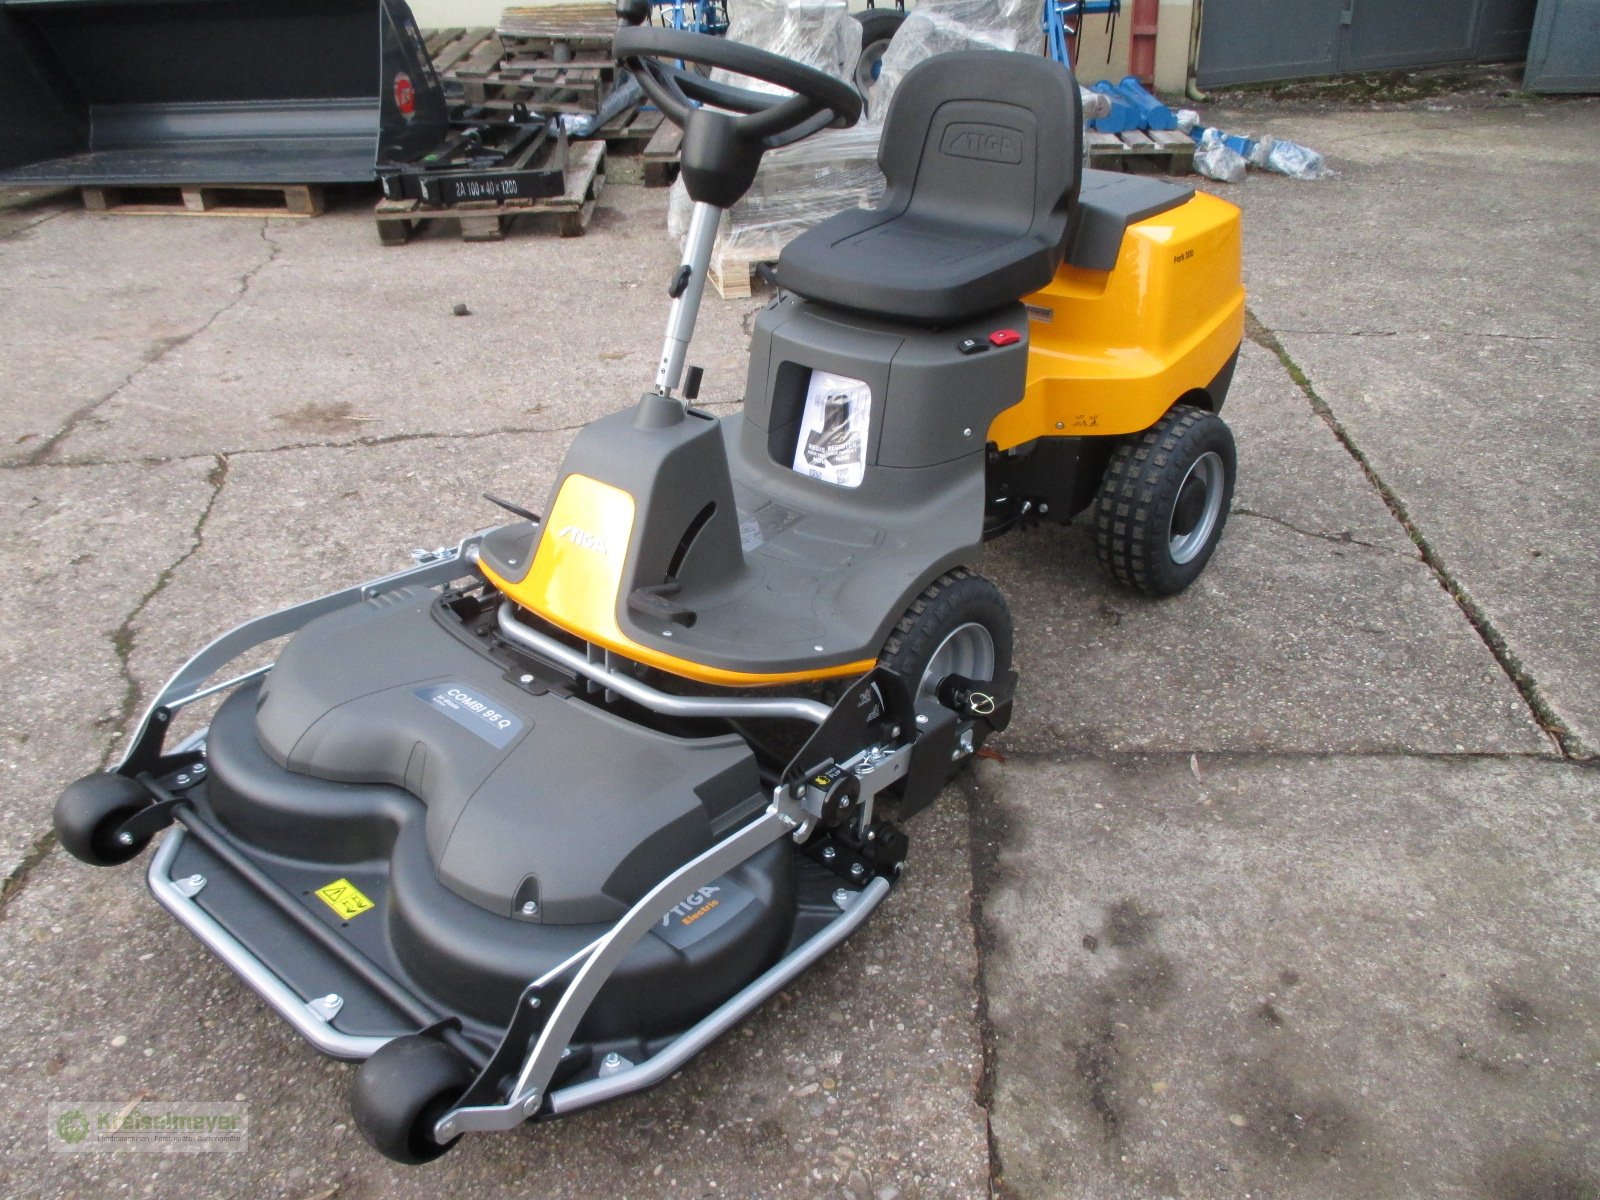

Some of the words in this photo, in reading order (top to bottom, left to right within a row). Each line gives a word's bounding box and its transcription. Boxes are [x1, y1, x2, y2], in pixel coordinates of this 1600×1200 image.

[466, 181, 480, 197] 100
[485, 182, 495, 195] 40
[501, 179, 518, 195] 1200
[447, 688, 488, 713] COMBI
[482, 709, 503, 722] 95
[497, 719, 512, 730] Q
[662, 886, 721, 927] STIGA
[681, 899, 719, 925] Electric
